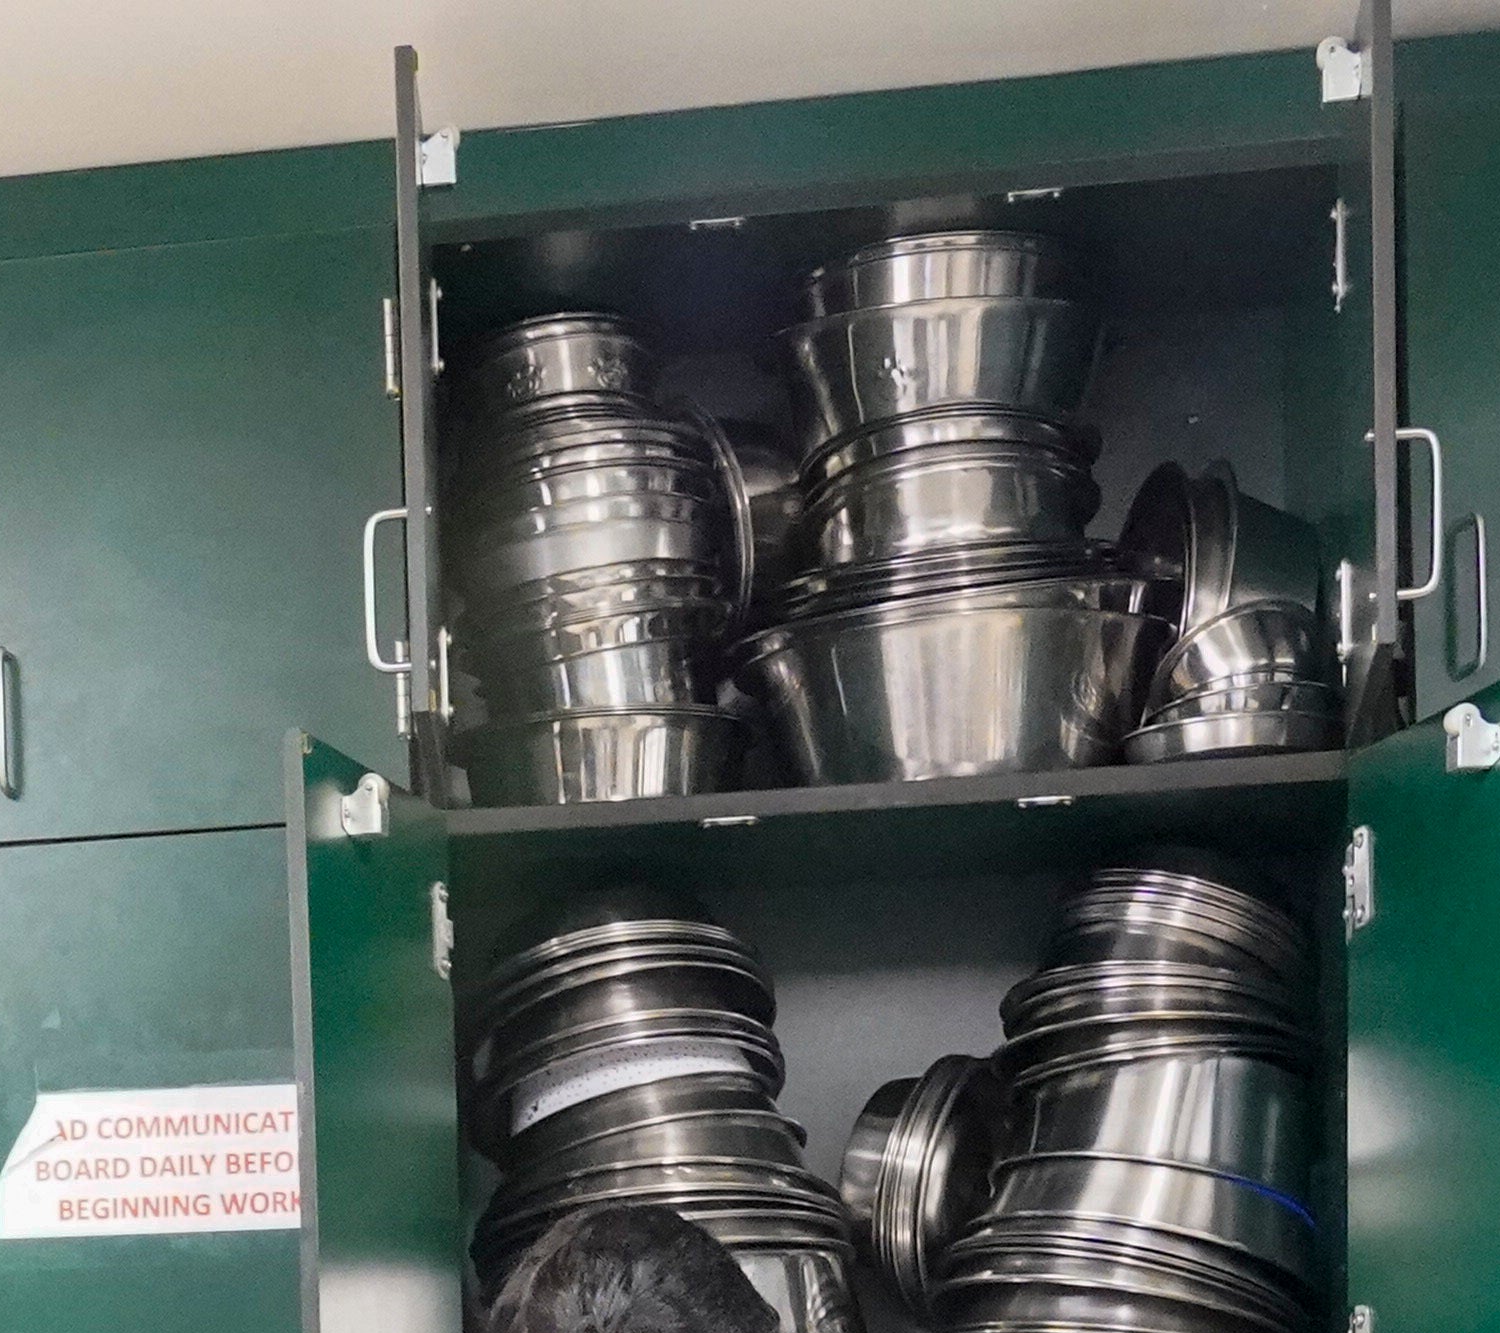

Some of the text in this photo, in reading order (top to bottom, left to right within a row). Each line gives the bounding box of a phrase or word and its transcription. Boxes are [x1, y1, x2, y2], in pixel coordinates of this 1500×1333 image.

[55, 1111, 294, 1141] AD COMMUNICAT
[35, 1151, 294, 1182] BOARD DAILY BEFO
[58, 1191, 300, 1221] BEGINNING WORK
